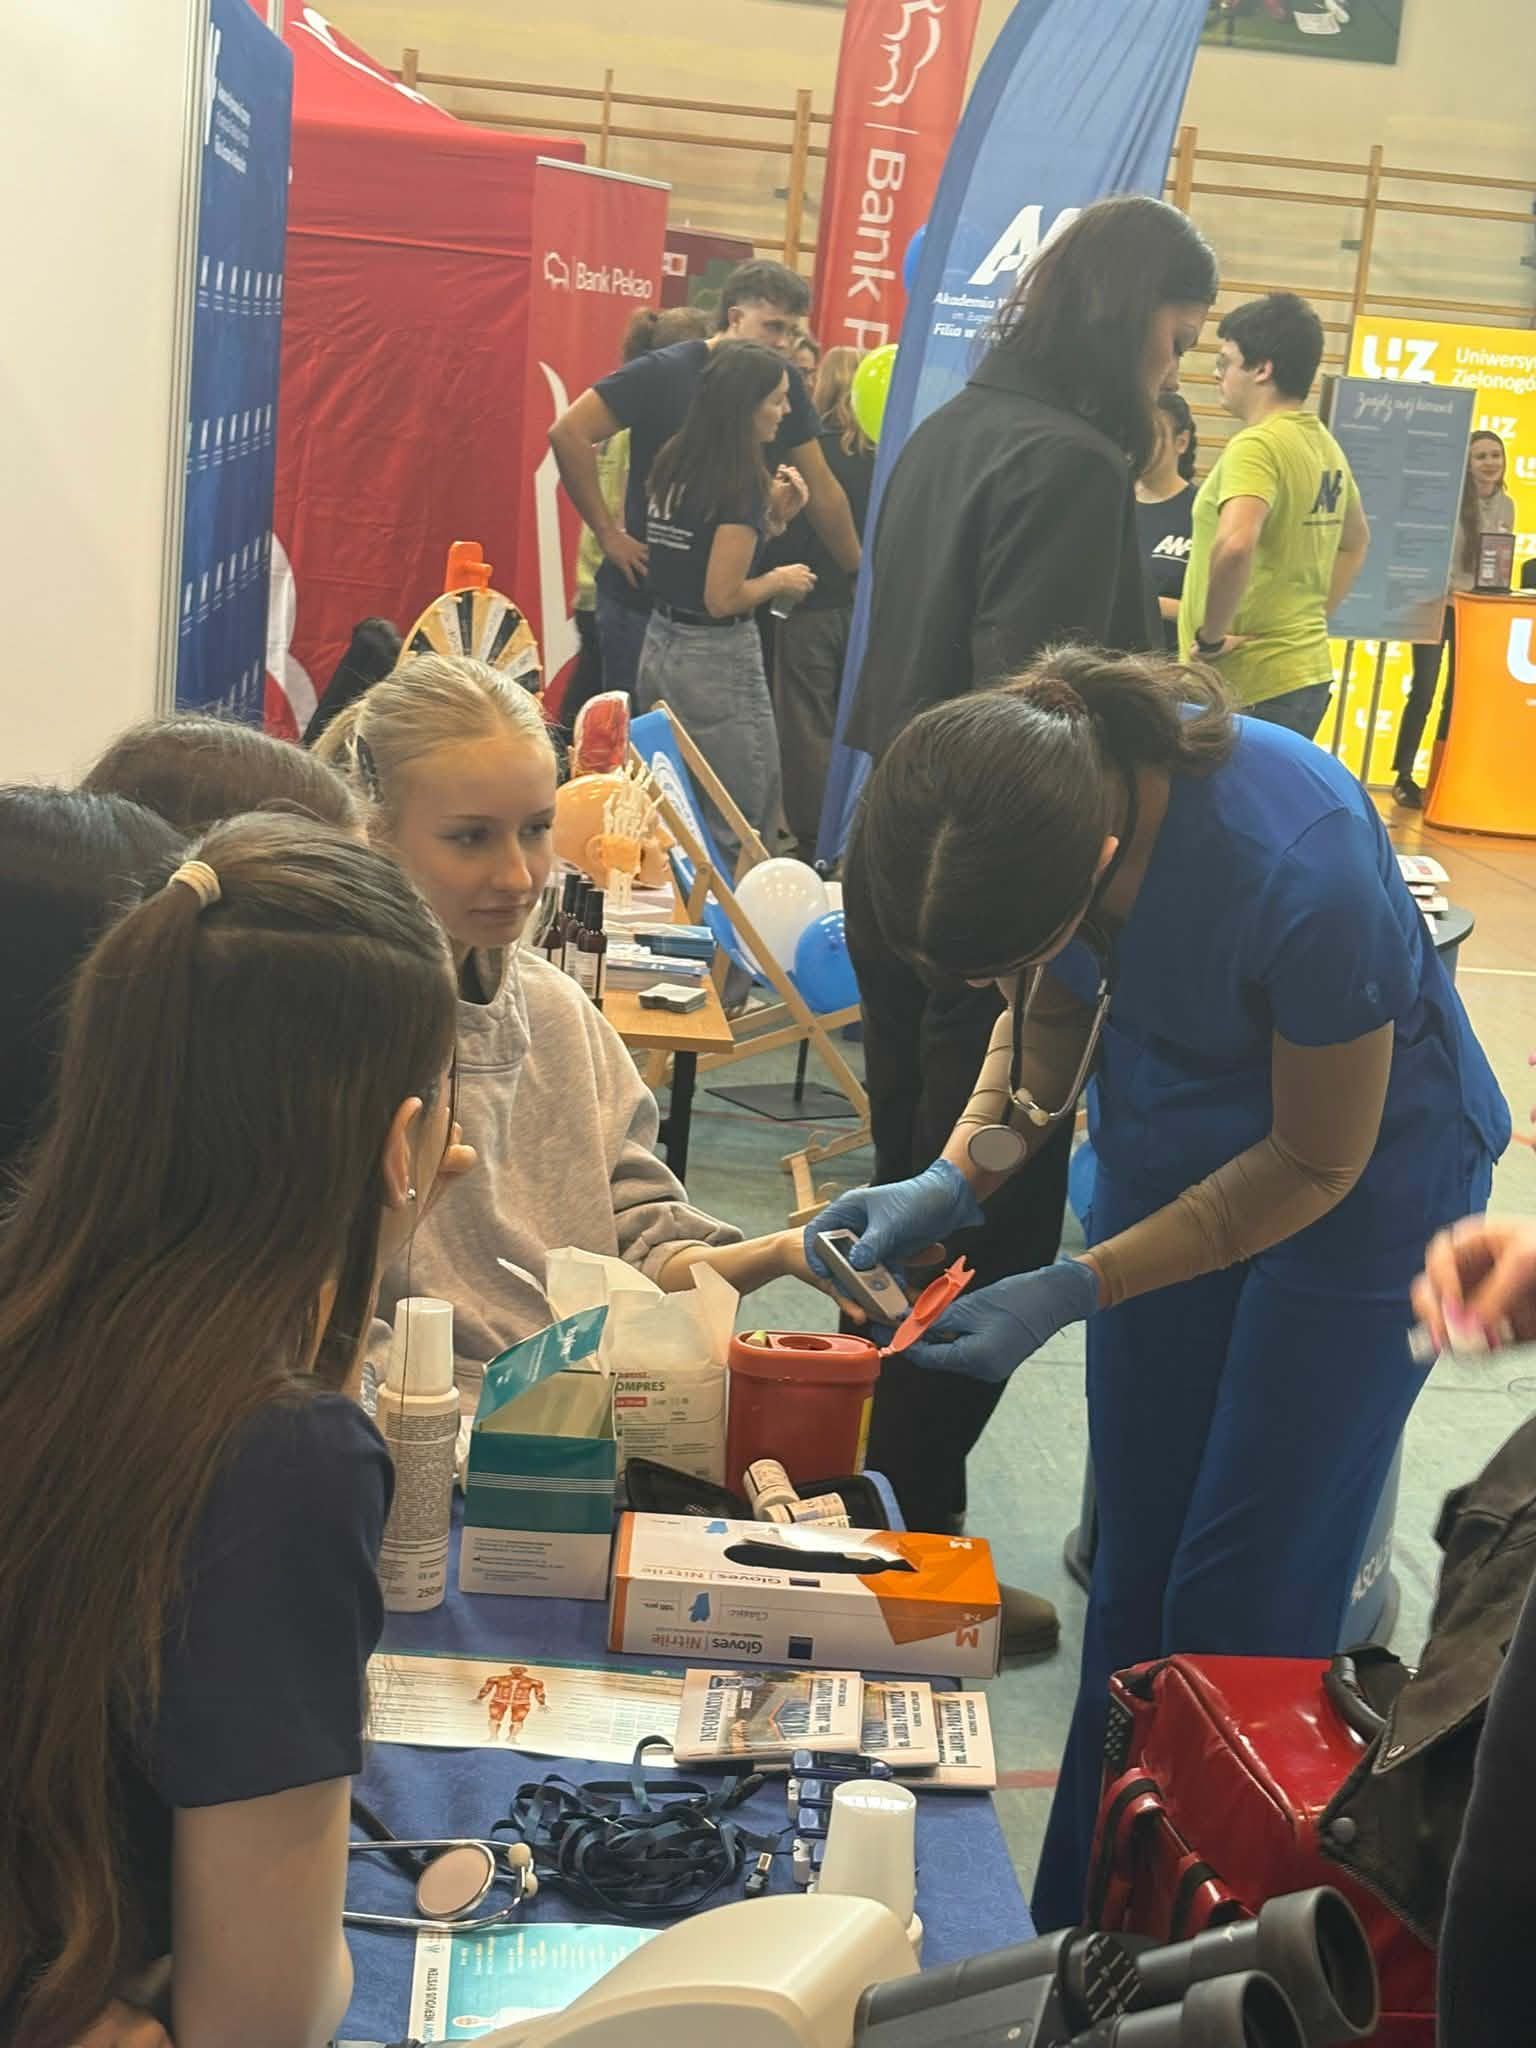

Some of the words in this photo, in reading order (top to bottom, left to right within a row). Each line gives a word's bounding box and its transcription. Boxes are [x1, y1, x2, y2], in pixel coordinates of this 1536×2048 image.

[847, 147, 906, 302] Bank
[576, 261, 610, 293] Bank
[611, 267, 653, 299] Pekao
[1361, 335, 1440, 382] UZ
[641, 1567, 703, 1579] Nitrile
[718, 1573, 782, 1585] Gloves
[651, 1632, 701, 1649] Nitrile
[711, 1636, 763, 1654] Gloves
[955, 1627, 979, 1649] M
[699, 1690, 724, 1742] INFORMATOR
[425, 1967, 439, 1992] SYSTEM
[423, 1991, 437, 2021] NERVOUS
